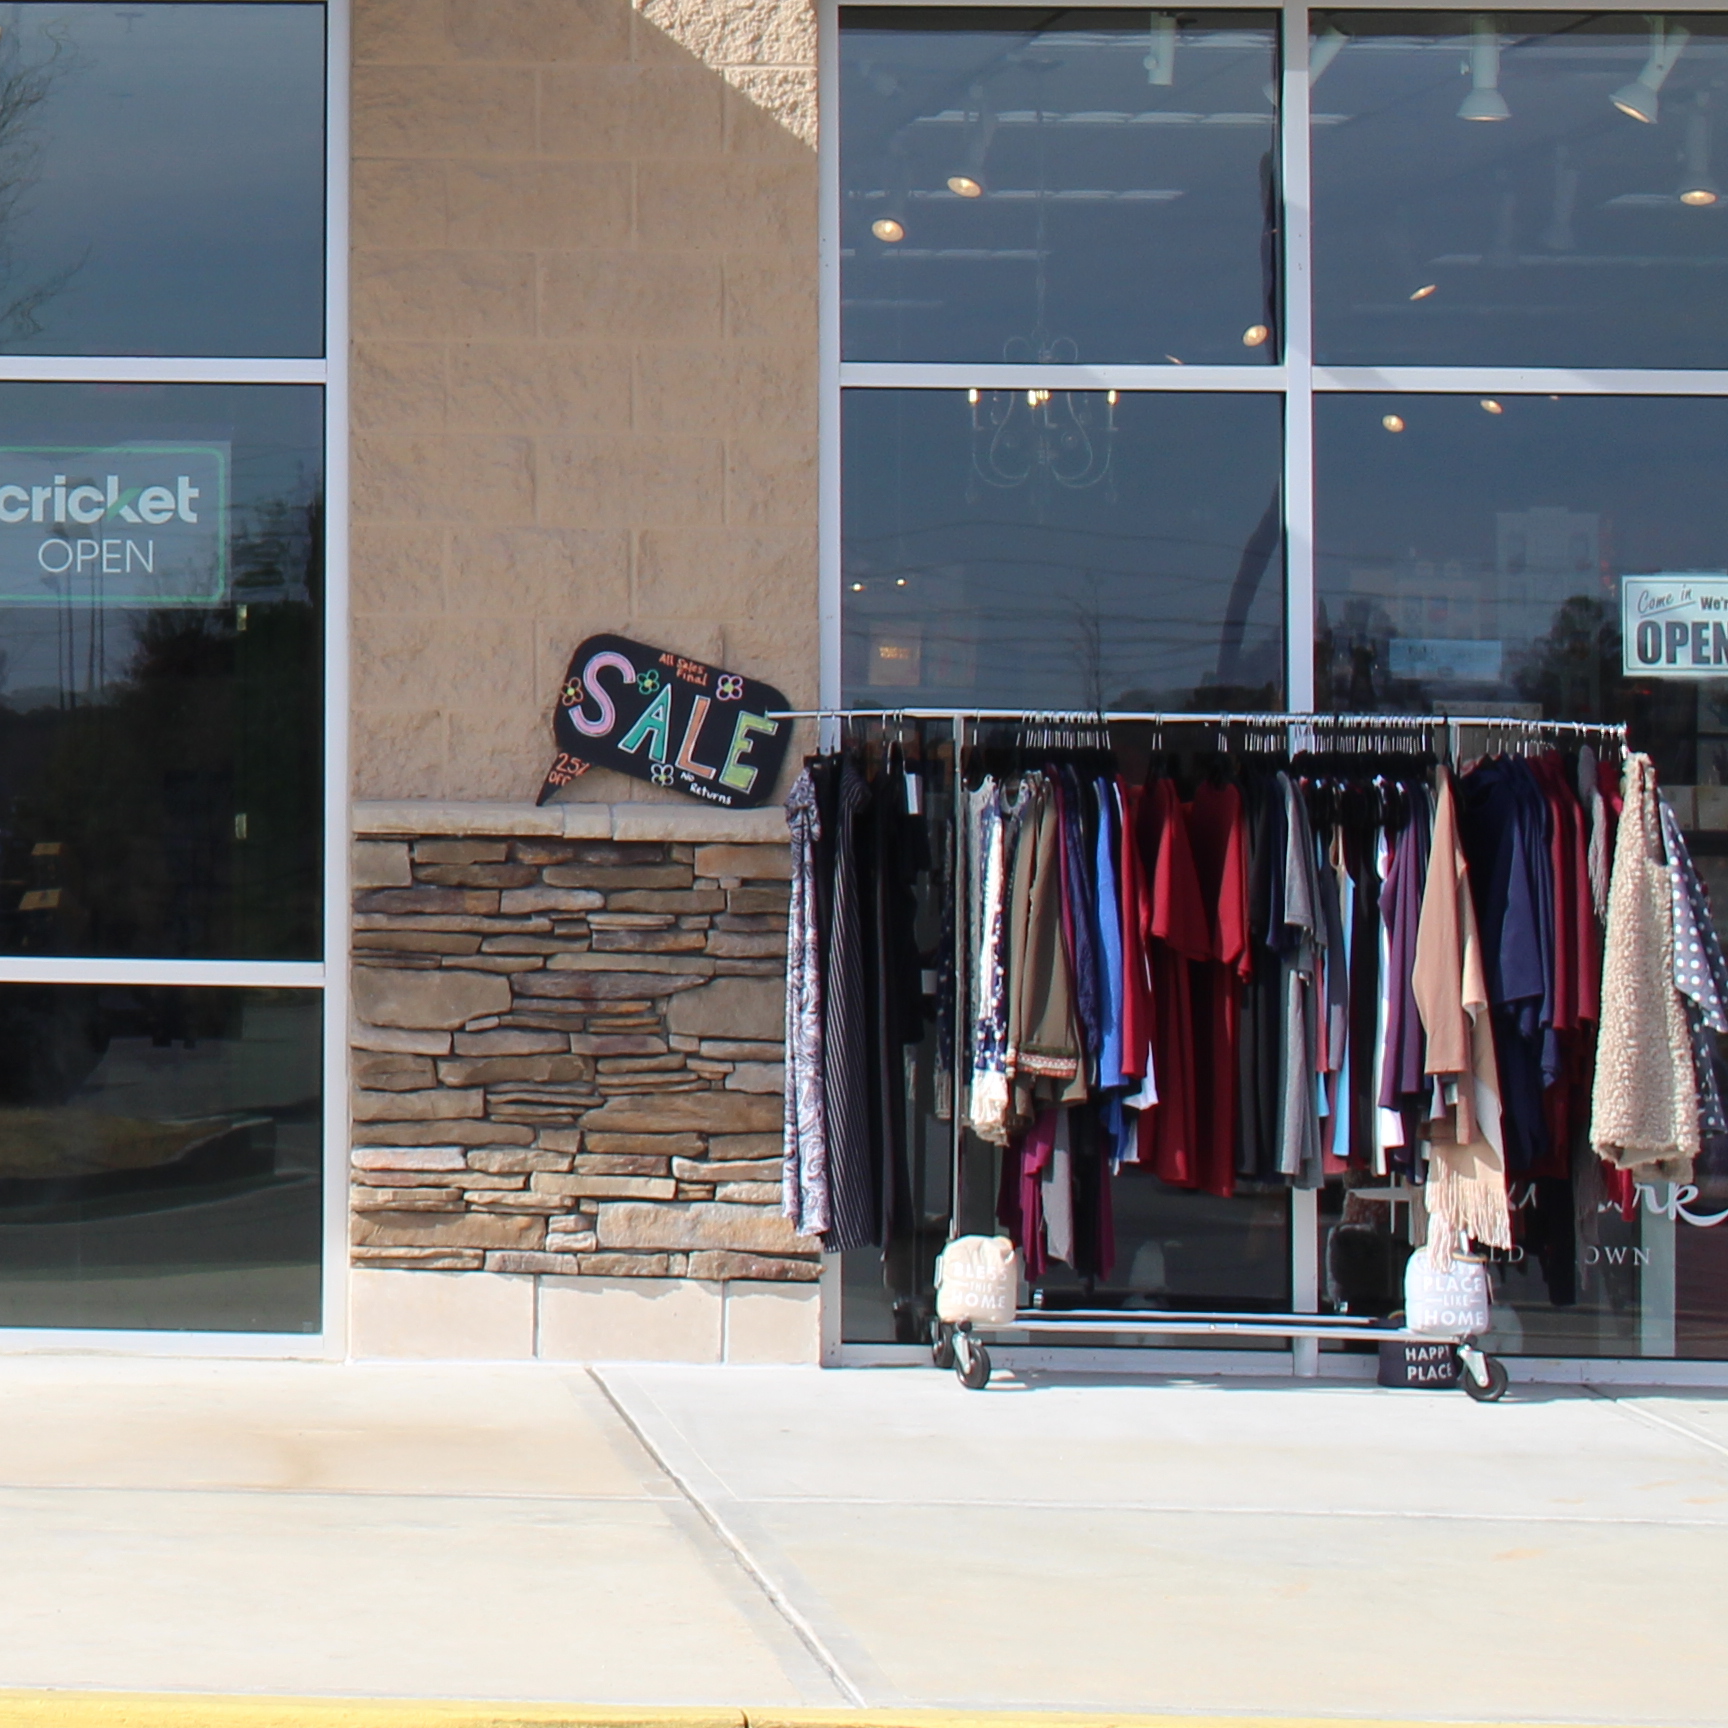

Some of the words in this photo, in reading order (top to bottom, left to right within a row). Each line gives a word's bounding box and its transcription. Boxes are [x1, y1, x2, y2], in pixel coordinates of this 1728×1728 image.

[38, 538, 154, 573] OPEN
[1637, 589, 1674, 614] Come
[1680, 583, 1693, 601] in
[658, 652, 675, 667] All
[676, 658, 706, 675] Sales
[676, 669, 707, 686] Final
[568, 650, 779, 795] SALE
[555, 752, 591, 777] 25%
[680, 771, 695, 783] No
[689, 782, 732, 805] Returns
[952, 1261, 1008, 1281] BLESS
[1422, 1276, 1482, 1292] PLACE
[950, 1289, 1006, 1309] HOME
[1443, 1294, 1469, 1307] LIKE
[1424, 1310, 1484, 1327] HOME
[1406, 1363, 1453, 1381] PLACE
